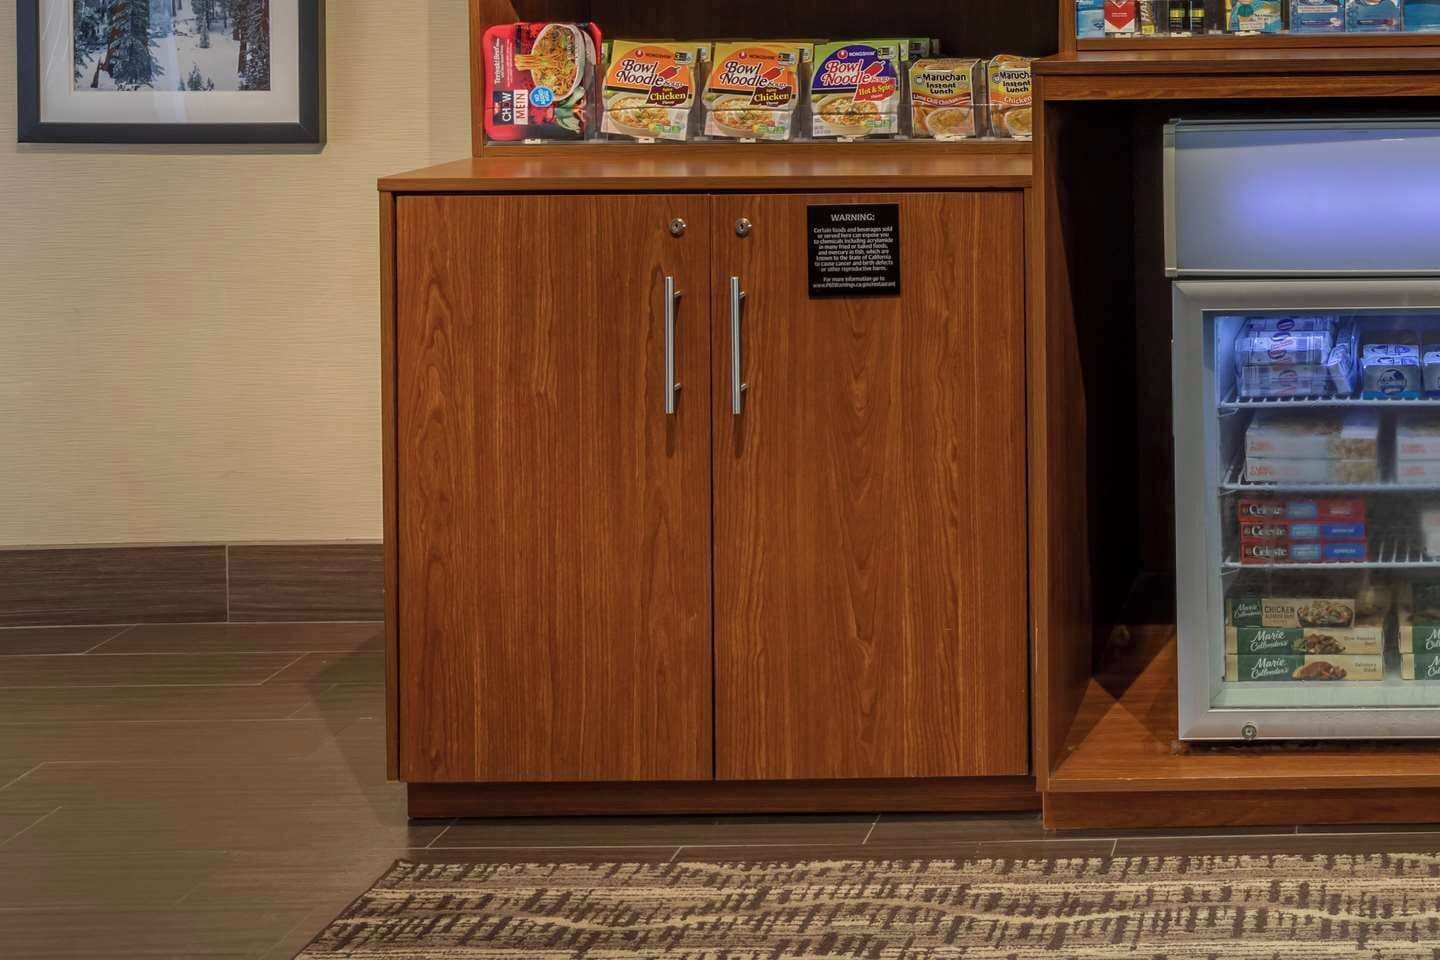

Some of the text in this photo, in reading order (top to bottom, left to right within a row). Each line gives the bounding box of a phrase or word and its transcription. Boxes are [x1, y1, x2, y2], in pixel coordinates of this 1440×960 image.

[622, 59, 659, 74] Bowl
[726, 61, 763, 75] Bowl
[825, 59, 864, 73] Bowl
[616, 70, 664, 87] Noodle
[719, 71, 768, 87] Noodle
[821, 71, 870, 86] Noodle
[922, 73, 966, 82] Maruchan
[1000, 71, 1031, 81] Maruch
[650, 91, 686, 101] Chicken
[754, 93, 790, 102] Chicken
[516, 93, 526, 119] MEIN
[1264, 605, 1295, 613] CHICKEN
[1251, 630, 1287, 642] Marie
[1252, 658, 1287, 670] Marie
